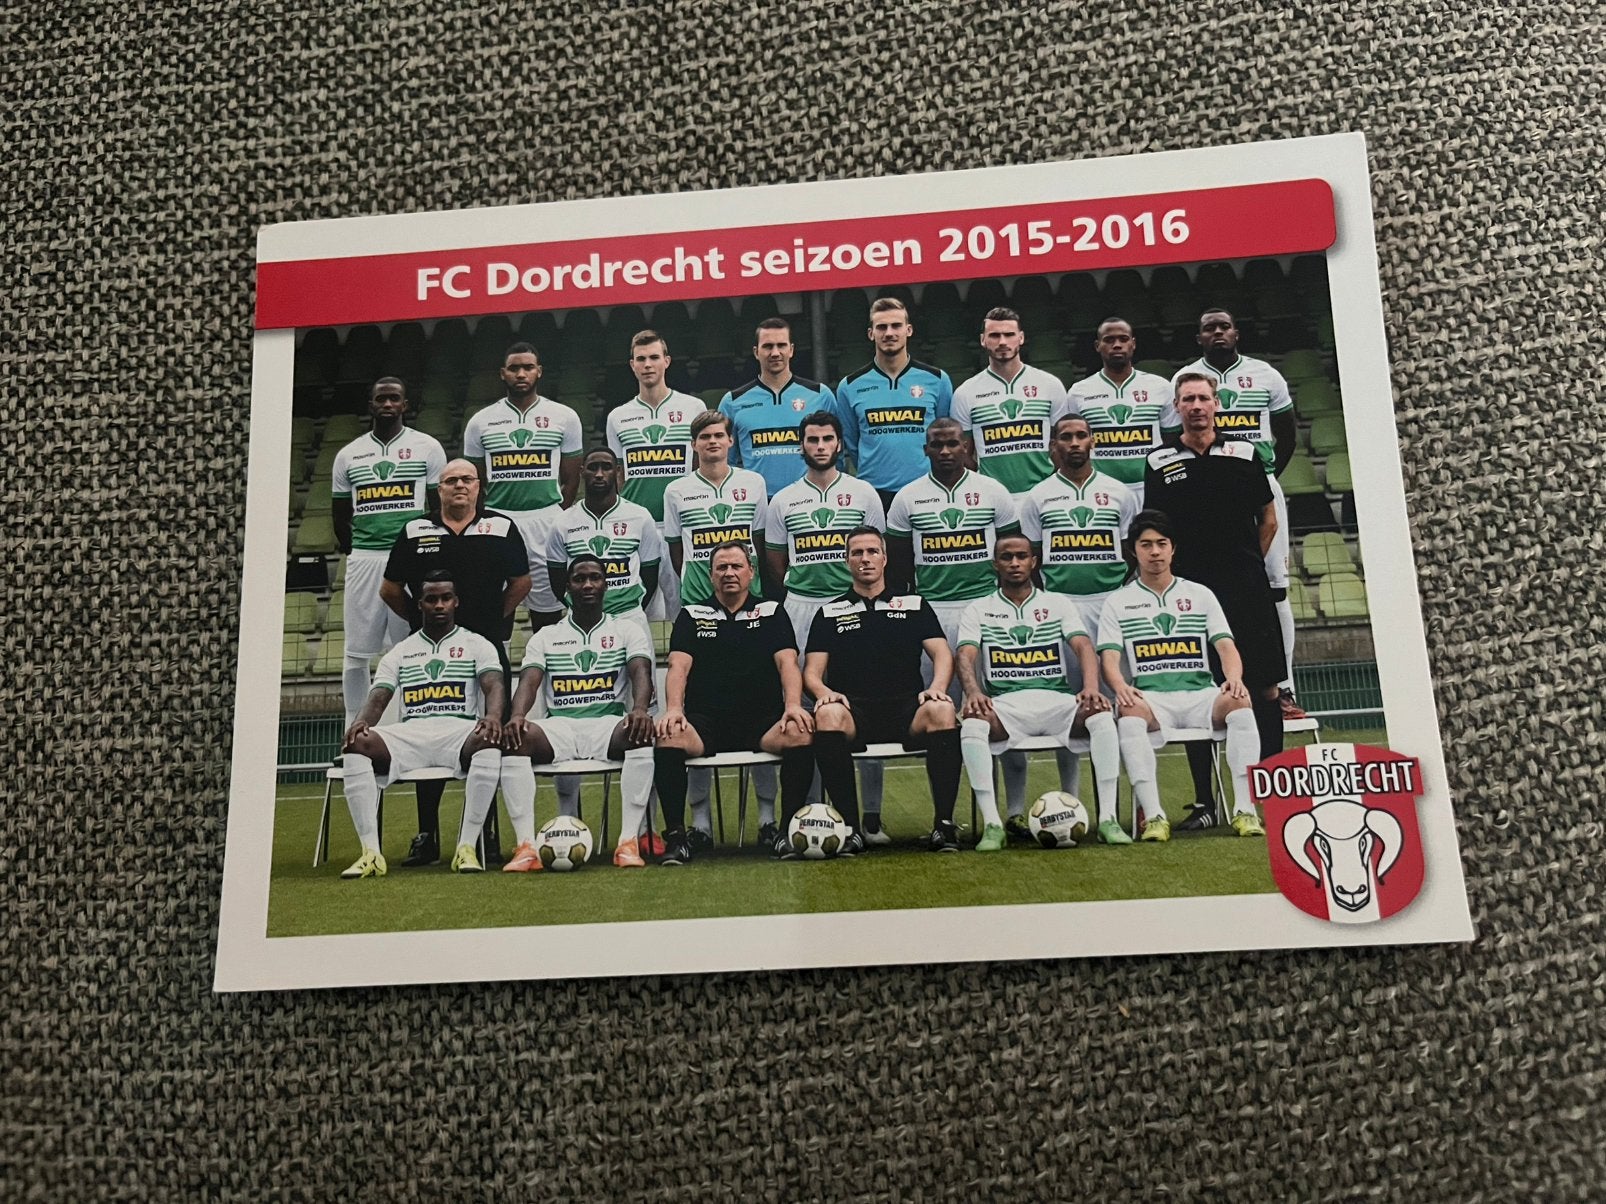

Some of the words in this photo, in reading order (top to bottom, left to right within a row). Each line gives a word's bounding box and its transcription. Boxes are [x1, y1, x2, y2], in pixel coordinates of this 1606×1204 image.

[418, 264, 470, 300] FC
[486, 246, 725, 296] Dordrecht
[740, 237, 923, 278] seizoen
[938, 209, 1189, 262] 2015-2016
[868, 410, 923, 423] RIWAL
[1214, 415, 1259, 428] WAL
[752, 431, 800, 444] RIWA
[985, 425, 1042, 442] RIWAL
[1095, 430, 1152, 444] RIWAL
[492, 453, 549, 467] RIWAL
[627, 449, 683, 465] RIWAL
[491, 471, 551, 480] HOOGWERKERS
[628, 467, 685, 476] HOOGWERKERS
[357, 483, 413, 501] RIWAL
[356, 502, 415, 513] HOOGWERKERS
[693, 529, 751, 545] RIWAL
[923, 532, 985, 549] RIWAL
[1052, 533, 1113, 548] RIWAL
[795, 552, 847, 563] HOOGWERKE
[923, 552, 988, 562] HOOGWERKERS
[1050, 553, 1117, 562] HOOGWERKERS
[746, 620, 760, 629] JE
[1135, 640, 1201, 658] RIWAL
[992, 648, 1059, 665] RIWAL
[990, 667, 1062, 678] HOOGWERKERS
[1137, 661, 1204, 672] HOOGWERKERS
[553, 676, 613, 692] RIWAL
[404, 685, 464, 703] RIWAL
[1322, 748, 1338, 761] FC
[1252, 761, 1416, 799] DORDRECHT
